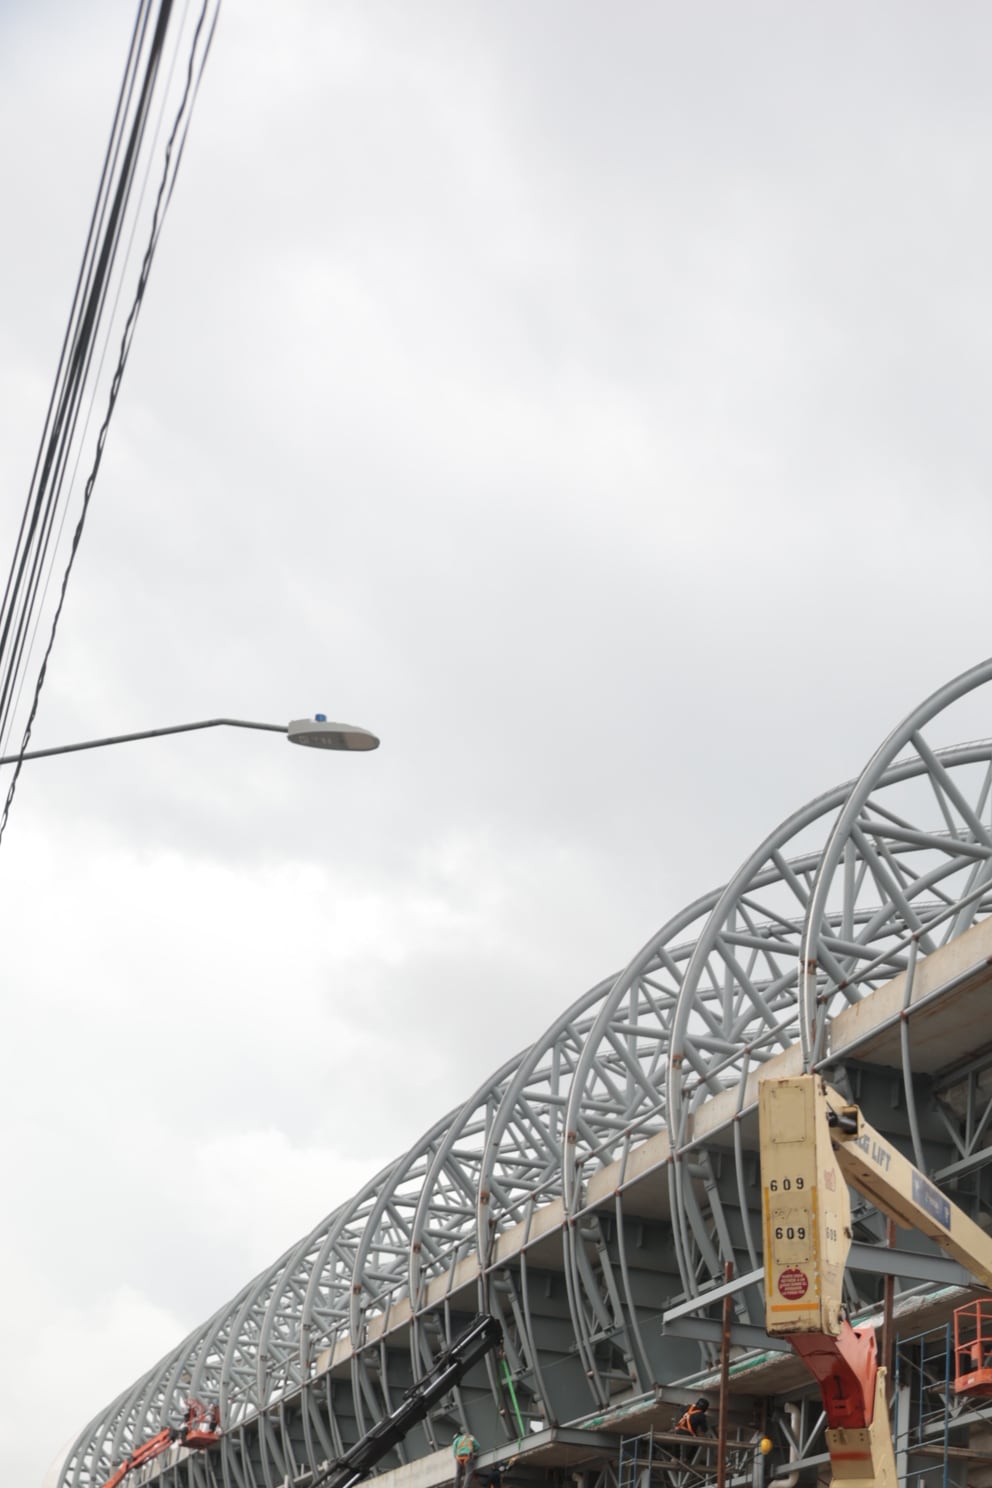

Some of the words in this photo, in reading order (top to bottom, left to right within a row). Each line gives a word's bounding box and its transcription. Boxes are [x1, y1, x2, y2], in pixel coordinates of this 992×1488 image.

[872, 1142, 891, 1172] LIFT
[770, 1177, 804, 1192] 609
[775, 1227, 806, 1240] 609
